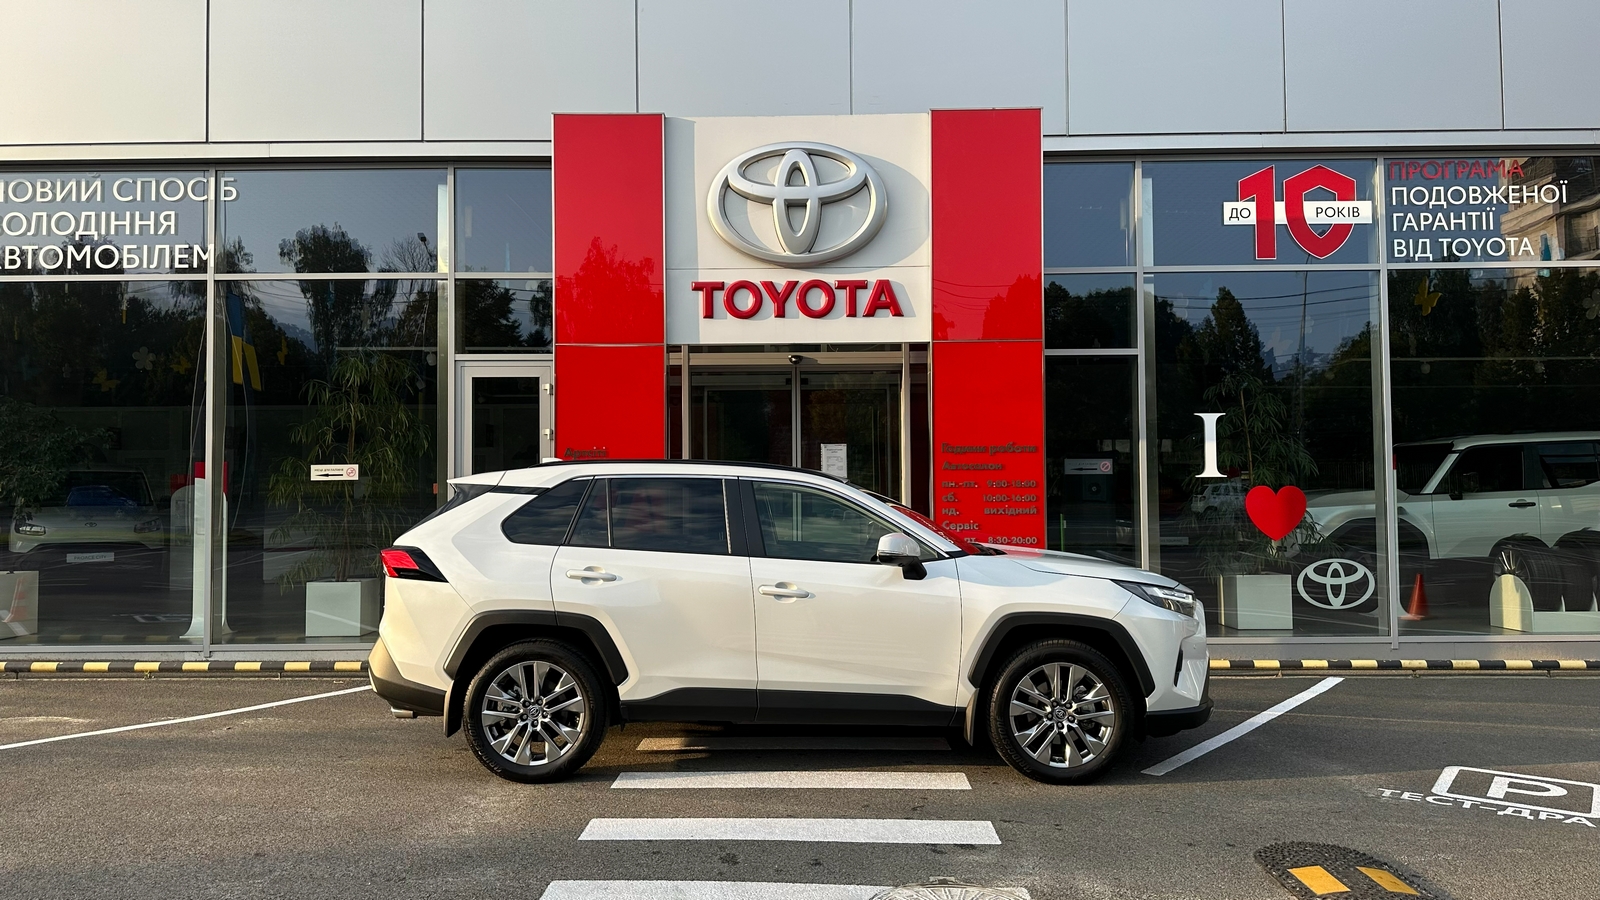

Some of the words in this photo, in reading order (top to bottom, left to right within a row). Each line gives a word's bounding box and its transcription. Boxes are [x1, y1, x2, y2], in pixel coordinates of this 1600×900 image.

[1390, 160, 1525, 180] ПРОГРАМА
[0, 172, 101, 203] ОВИЙ
[112, 177, 238, 202] СПОСІБ
[1392, 180, 1568, 209] ПОДОВЖЕНОЇ
[1228, 207, 1251, 222] ДО
[1238, 164, 1356, 260] 10
[1315, 206, 1361, 219] РОКІВ
[1393, 206, 1496, 232] ГАРАНТІЇ
[0, 211, 176, 241] ОЛОДІННЯ
[0, 243, 215, 270] ВТОМОБІЛЕМ
[1393, 238, 1434, 262] ВІД
[1438, 237, 1536, 257] TOYOTA
[691, 279, 904, 319] TOYOTA
[941, 442, 986, 454] Години
[989, 442, 1037, 455] роботи
[1193, 412, 1228, 478] I
[941, 461, 1003, 471] Автосалон
[987, 480, 1036, 488] 9:00-18:00
[941, 492, 958, 502] сб.
[983, 494, 1037, 502] 10:00-16:00
[941, 508, 960, 516] нд.
[984, 505, 1037, 516] вихідний
[941, 520, 979, 532] Сервіс
[987, 536, 1038, 545] 8:30-20:00
[1486, 775, 1568, 799] P
[1377, 787, 1597, 828] ТЕСТ-ДРА
